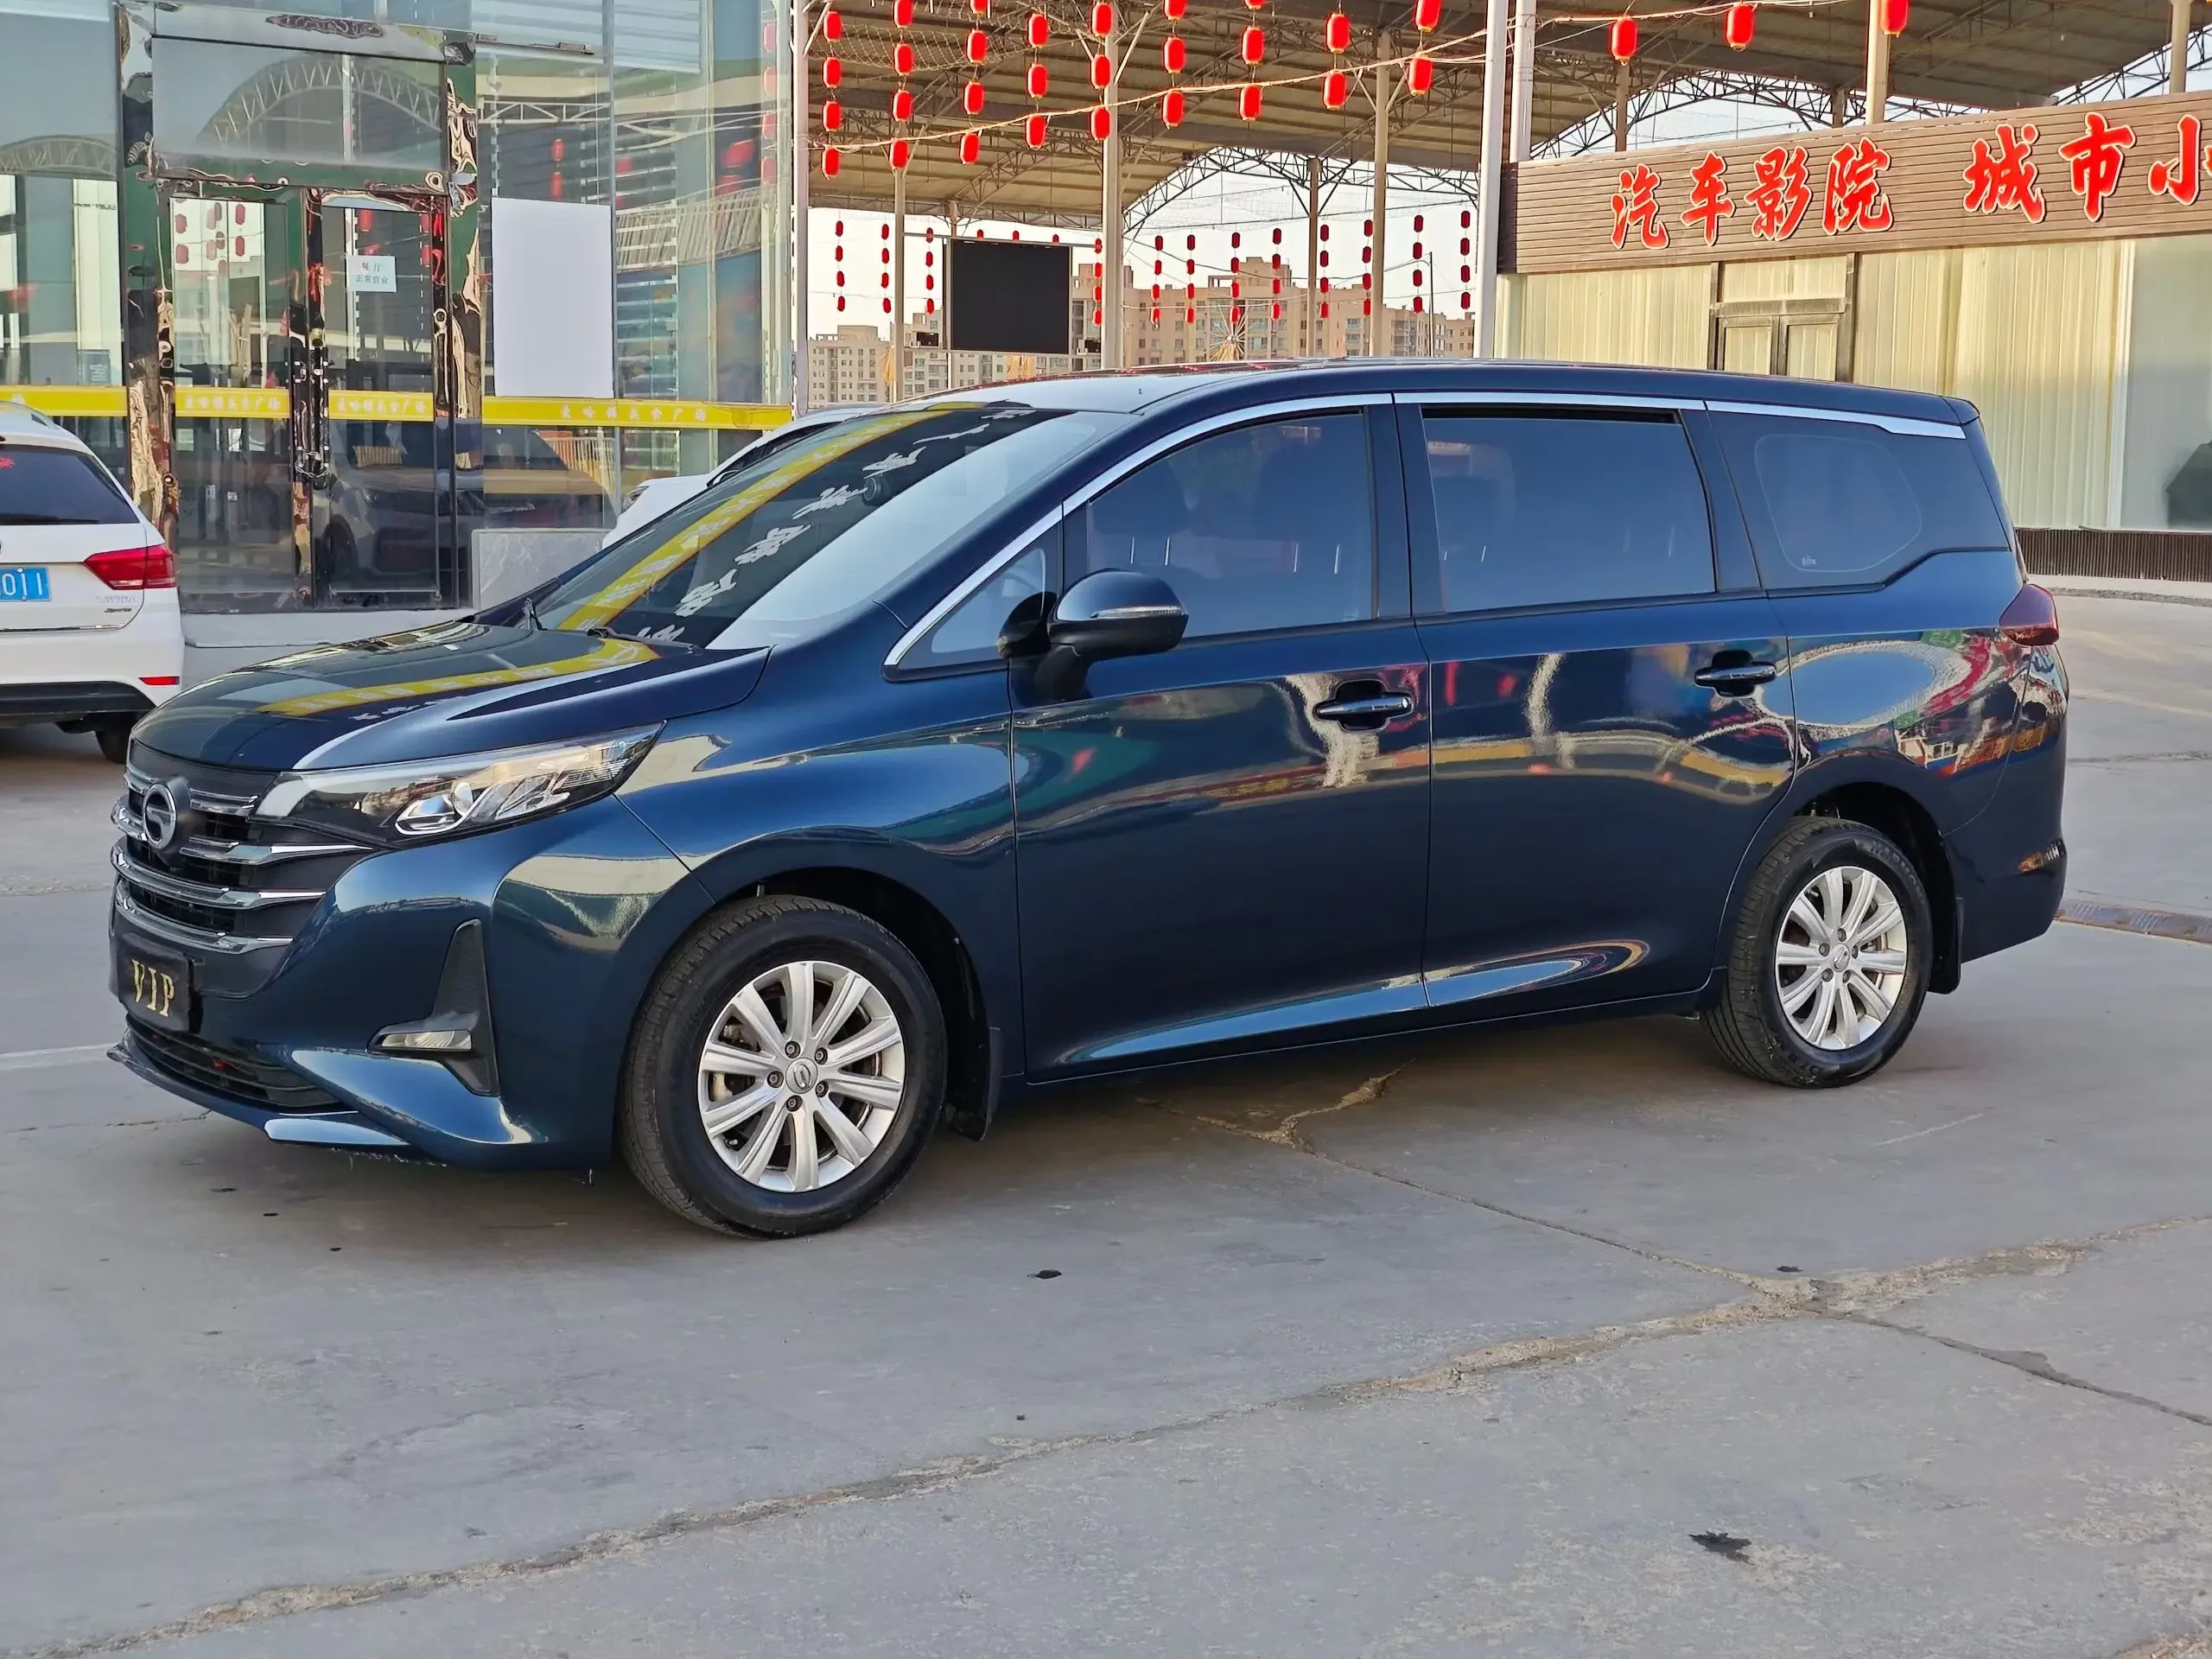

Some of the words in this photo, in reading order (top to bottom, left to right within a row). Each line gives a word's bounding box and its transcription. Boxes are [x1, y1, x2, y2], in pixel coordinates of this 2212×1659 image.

[1610, 137, 1895, 250] 汽车影院
[1962, 111, 2212, 224] 城市小
[0, 571, 43, 596] 011
[131, 958, 175, 1017] VIP
